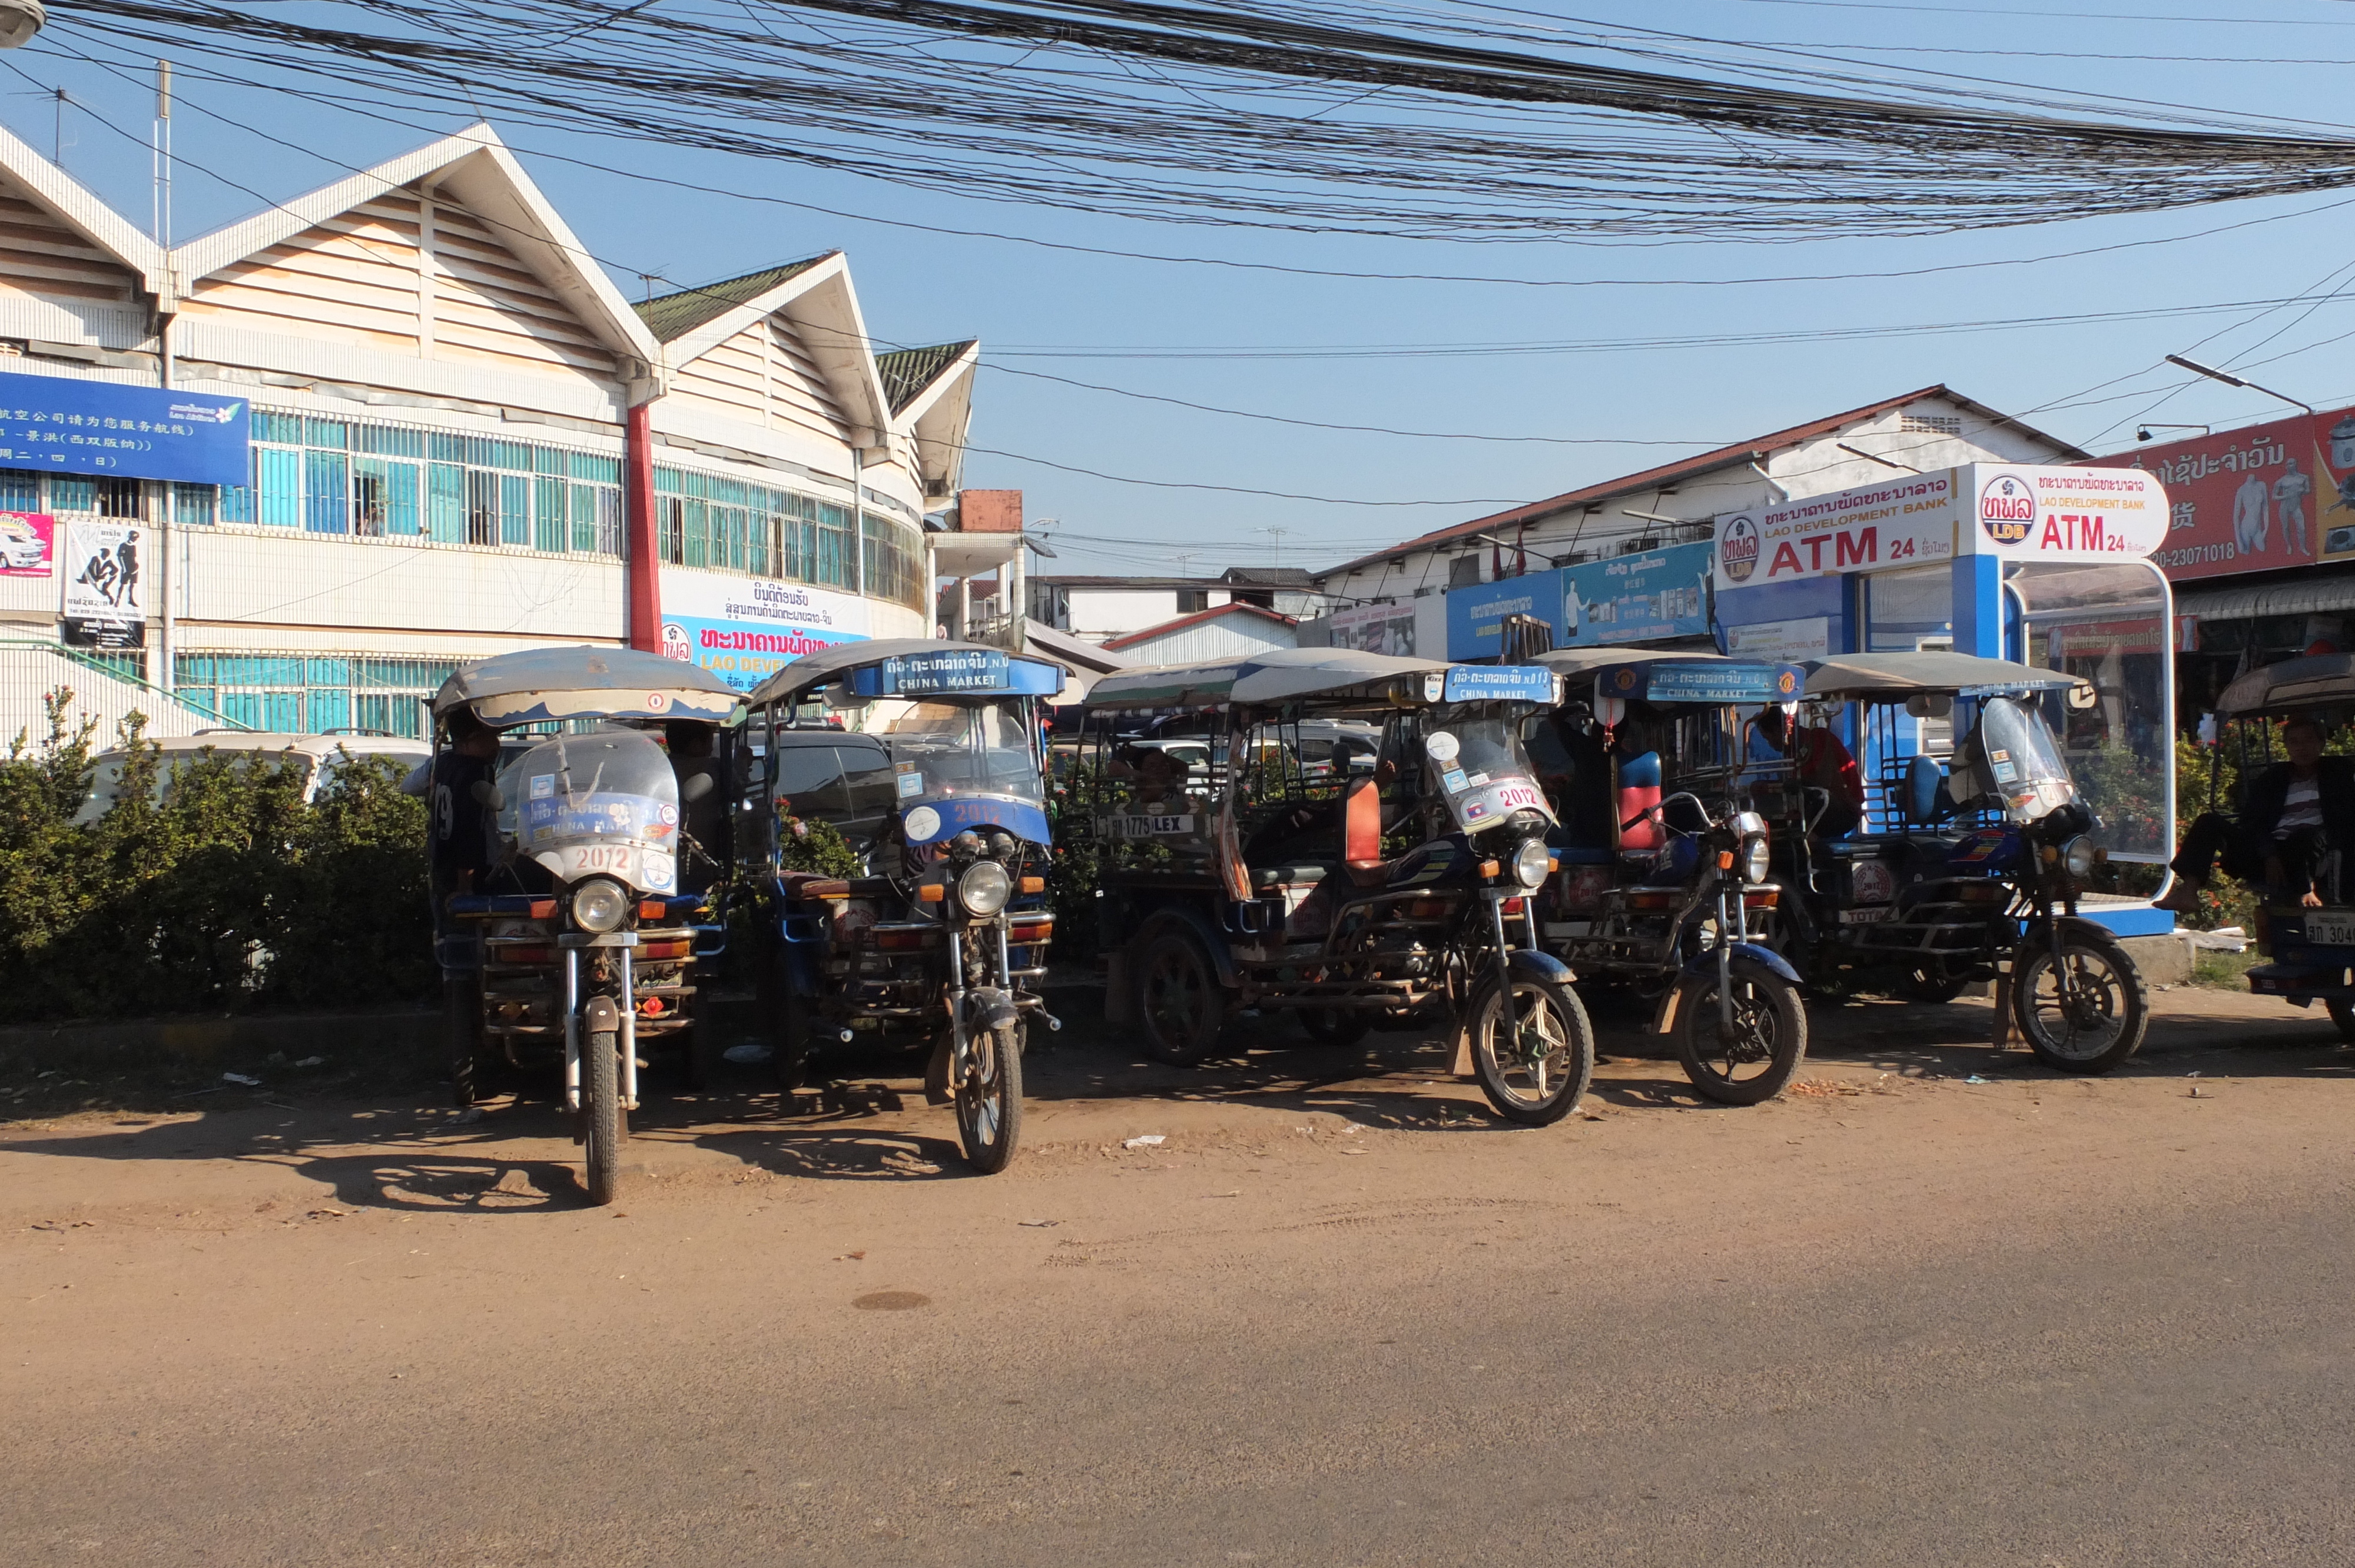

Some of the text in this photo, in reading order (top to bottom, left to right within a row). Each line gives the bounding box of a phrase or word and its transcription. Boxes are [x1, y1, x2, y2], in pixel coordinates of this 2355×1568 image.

[2039, 497, 2145, 510] LAO DEVELOPMENT BANK
[1764, 497, 1948, 539] LAO DEVELOPMENT BANK
[1992, 524, 2025, 539] LDB
[2041, 514, 2104, 551] ATM
[2107, 535, 2125, 552] 24
[1767, 526, 1878, 577] ATM
[1890, 537, 1915, 560] 24
[1730, 562, 1752, 578] LDB
[701, 654, 735, 670] LAO
[898, 675, 996, 689] CHINA MARKET
[1460, 689, 1526, 699] CHINA MARKET
[1667, 689, 1747, 698] CHINA MARKET
[1500, 788, 1537, 807] 2012
[954, 804, 1000, 824] 2012
[1127, 817, 1149, 836] 1775
[576, 848, 628, 869] 2012
